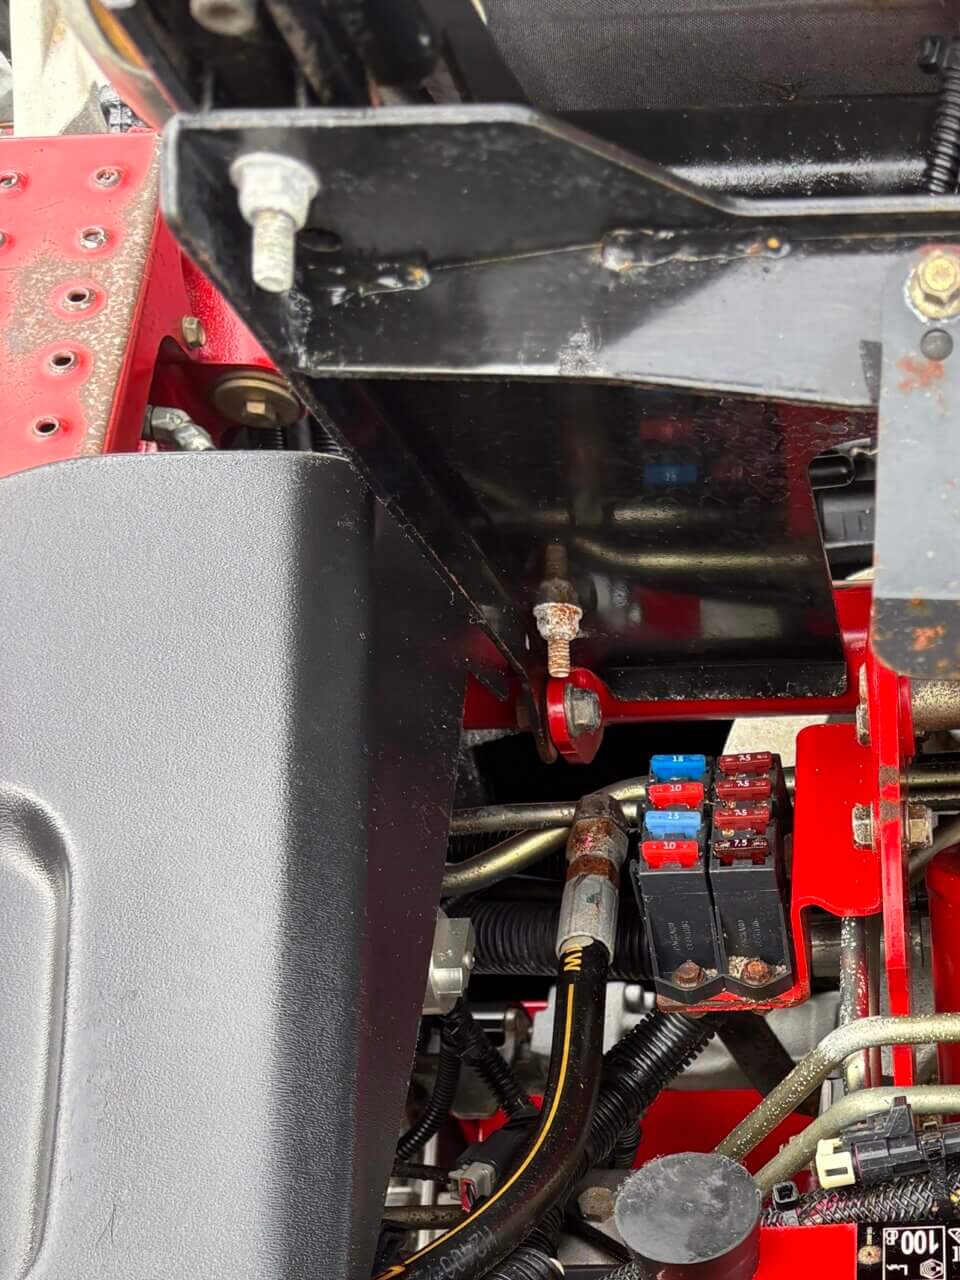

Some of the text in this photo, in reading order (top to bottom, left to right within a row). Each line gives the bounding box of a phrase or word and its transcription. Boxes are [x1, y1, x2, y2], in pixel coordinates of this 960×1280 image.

[670, 784, 682, 792] 10
[663, 842, 676, 850] 10
[733, 839, 747, 847] 7.5
[900, 1230, 939, 1255] 100
